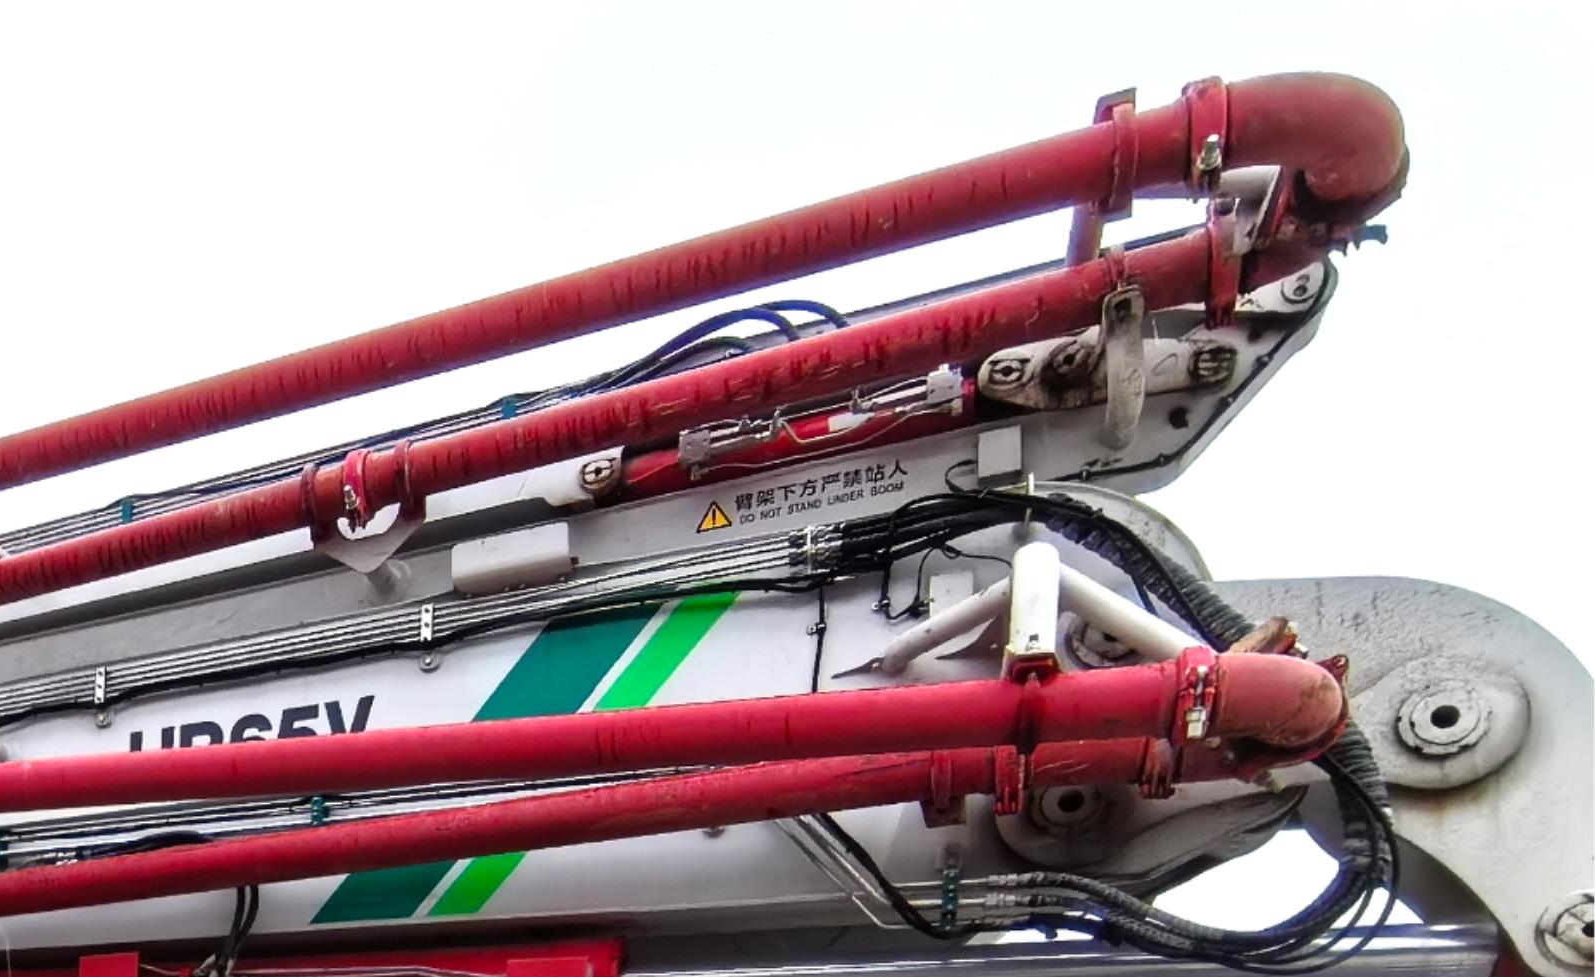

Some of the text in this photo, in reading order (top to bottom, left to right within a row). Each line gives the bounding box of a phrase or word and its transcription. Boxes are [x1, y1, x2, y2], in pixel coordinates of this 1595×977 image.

[735, 459, 908, 511] 臂架下方严禁站人
[739, 480, 905, 525] DO NOT STAND UNDER BOOM
